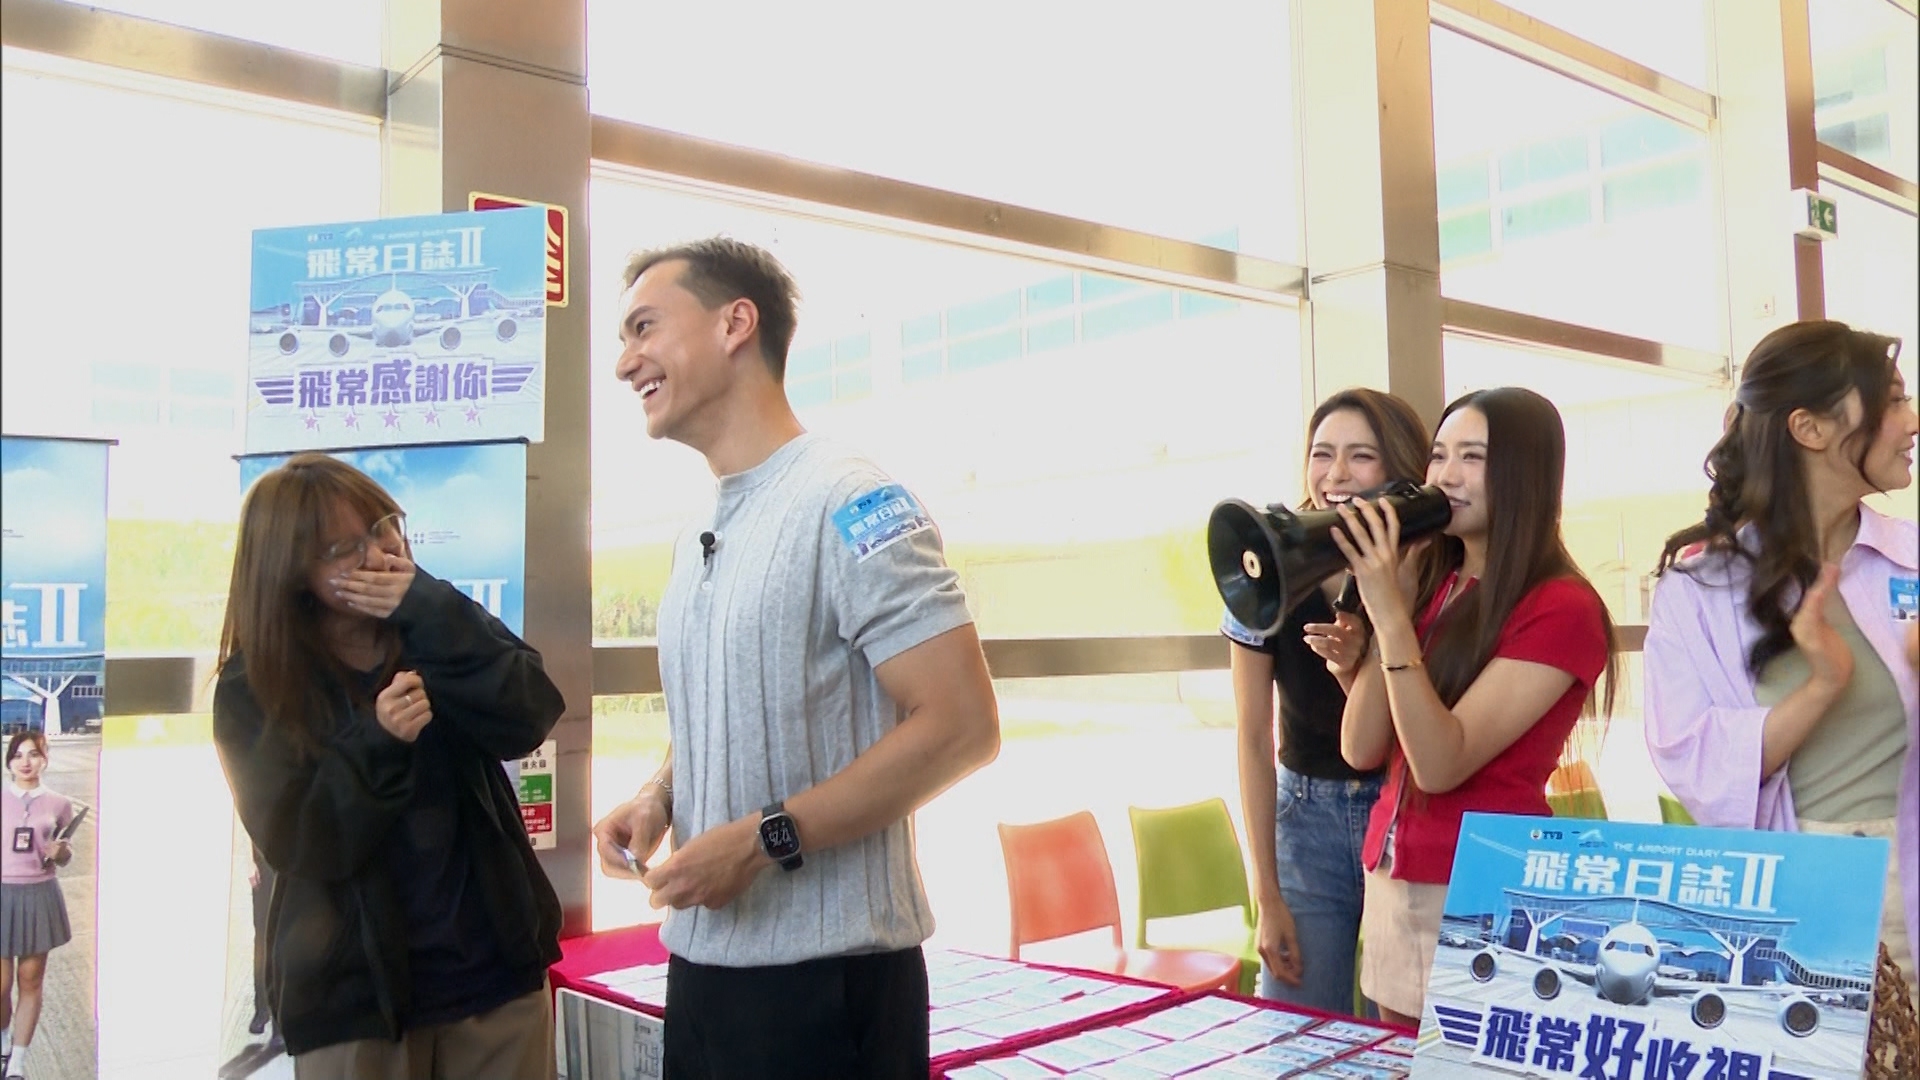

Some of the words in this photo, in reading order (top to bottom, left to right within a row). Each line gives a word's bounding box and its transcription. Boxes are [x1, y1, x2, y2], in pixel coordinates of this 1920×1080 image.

[299, 359, 488, 408] 飛常感謝你
[1614, 842, 1634, 852] THE
[1638, 844, 1683, 856] AIRPORT
[1685, 847, 1721, 858] DIARY
